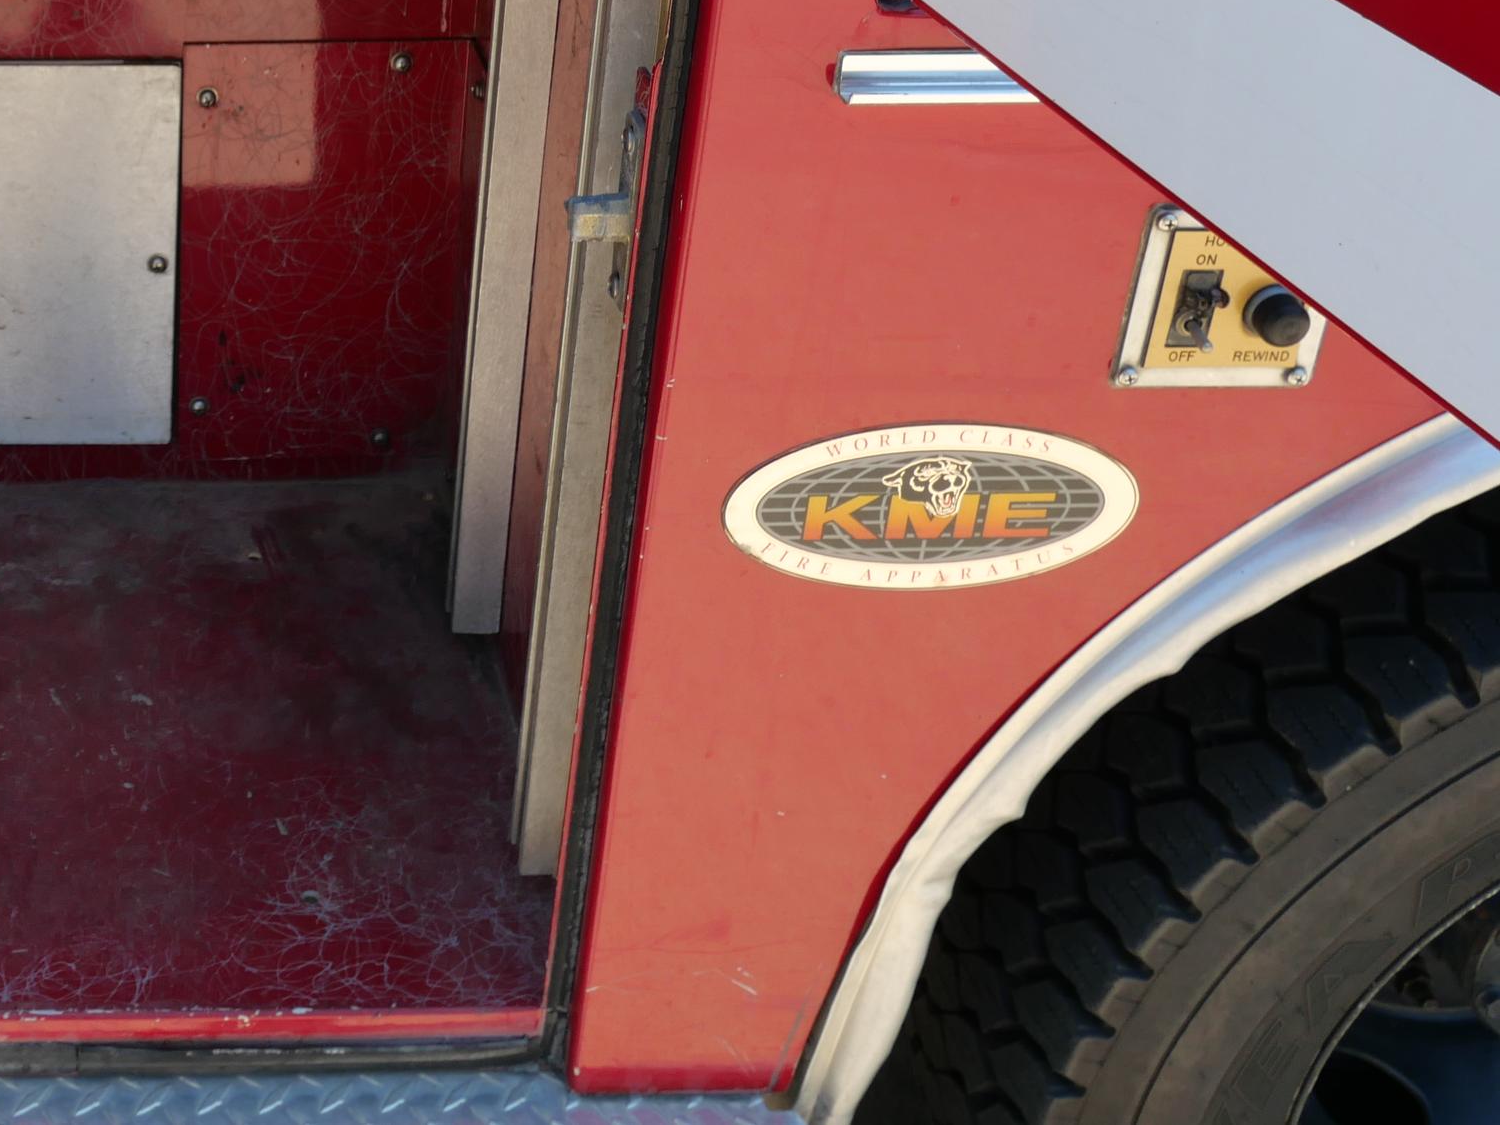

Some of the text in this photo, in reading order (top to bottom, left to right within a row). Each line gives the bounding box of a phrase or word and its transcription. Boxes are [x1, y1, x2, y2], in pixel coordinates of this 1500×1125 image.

[1204, 235, 1229, 247] HO
[1196, 253, 1217, 265] ON
[1168, 350, 1197, 362] OFF
[1232, 350, 1291, 362] REWIND
[824, 429, 1055, 458] WORLD CLASS
[802, 492, 1057, 541] KME
[760, 542, 1076, 585] FIRE APPARATUS
